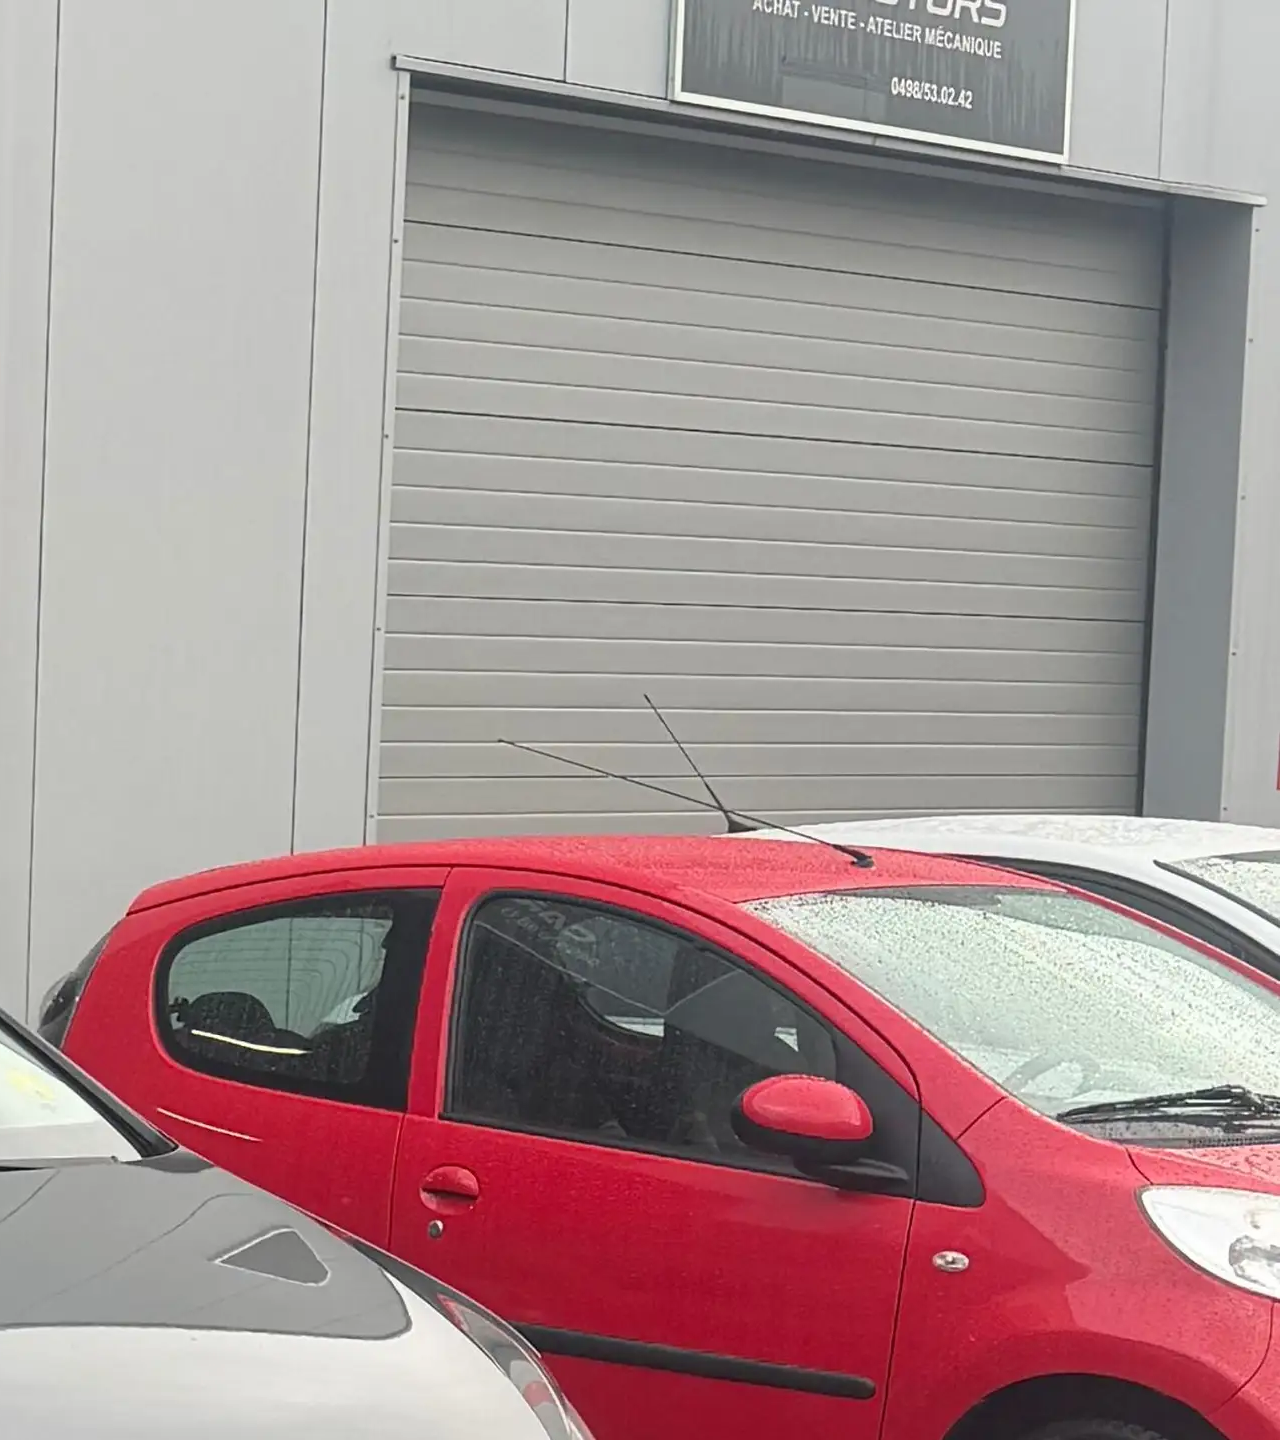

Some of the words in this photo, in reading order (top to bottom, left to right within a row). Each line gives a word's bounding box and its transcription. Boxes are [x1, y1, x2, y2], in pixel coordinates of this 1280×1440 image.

[752, 0, 801, 18] ACHAT
[811, 4, 858, 29] VENTE
[866, 16, 922, 43] ATELIER
[924, 26, 1003, 58] MÉCANIQUE
[891, 77, 973, 109] 0498/53.02.42
